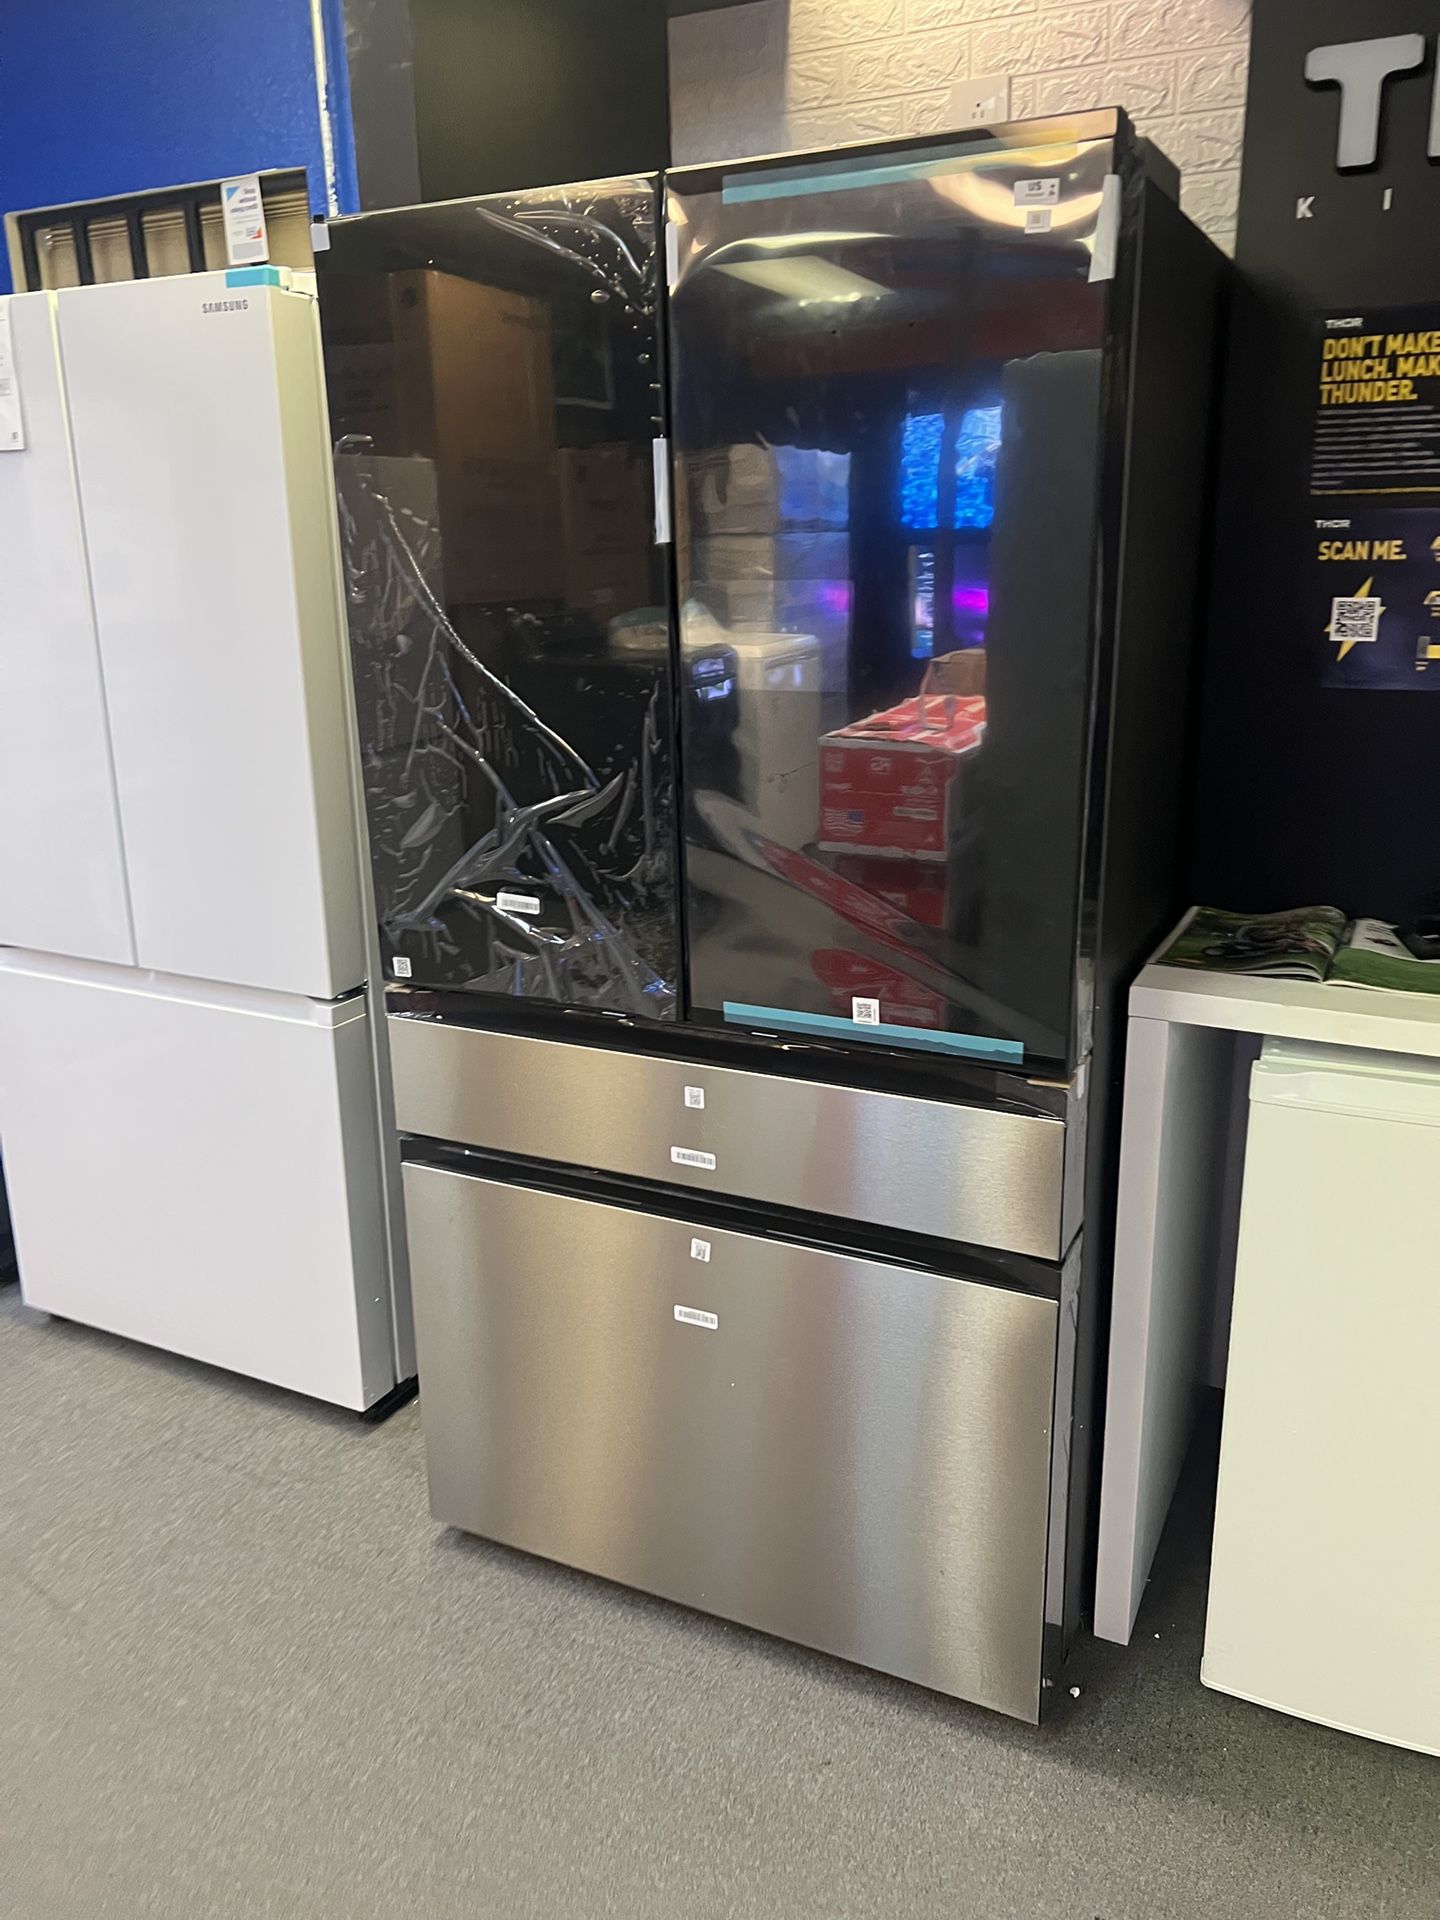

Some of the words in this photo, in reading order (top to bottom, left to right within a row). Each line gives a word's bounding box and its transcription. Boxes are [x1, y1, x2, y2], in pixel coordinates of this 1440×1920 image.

[1304, 33, 1440, 168] T
[202, 299, 249, 313] SAMSUNG
[1325, 317, 1364, 329] THOR
[1322, 334, 1385, 360] DON'T
[1385, 331, 1440, 356] MAKE
[1320, 358, 1393, 383] LUNCH.
[1319, 379, 1419, 405] THUNDER.
[1314, 519, 1351, 529] THOR
[1317, 540, 1371, 561] SCAN
[1372, 539, 1407, 560] ME.
